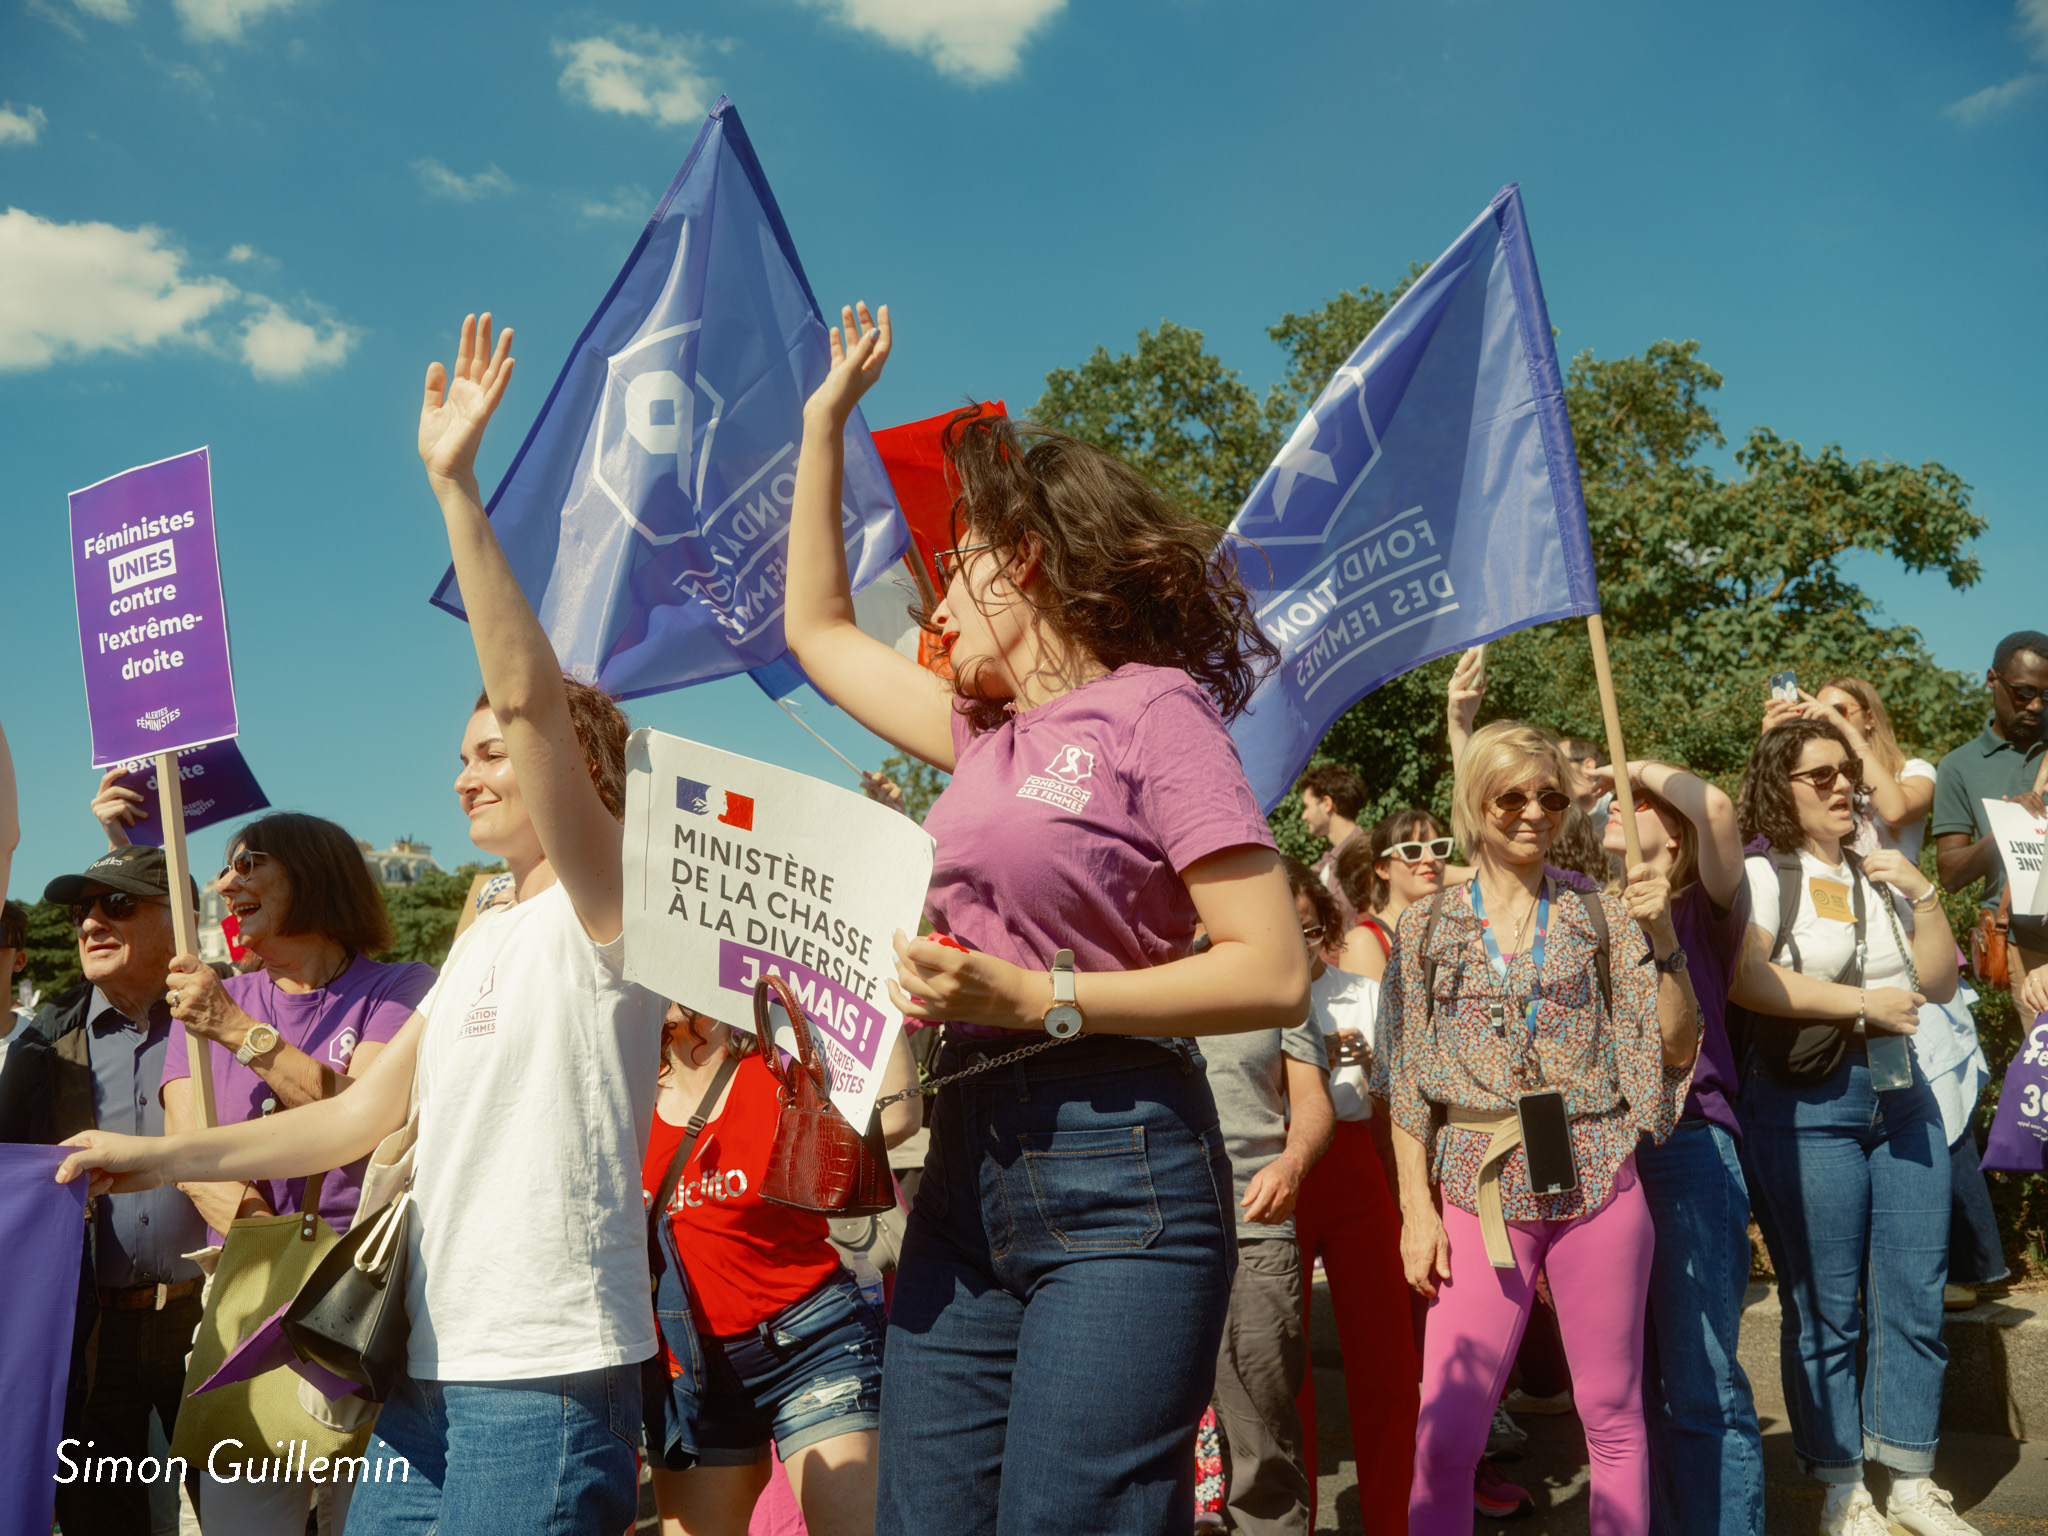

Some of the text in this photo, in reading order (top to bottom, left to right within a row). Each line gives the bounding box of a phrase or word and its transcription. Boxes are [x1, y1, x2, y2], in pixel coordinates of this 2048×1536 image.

[84, 510, 195, 559] Féministes
[112, 548, 173, 584] UNIES
[109, 584, 177, 616] contre
[98, 612, 203, 653] l'extrême-
[121, 648, 184, 680] droite
[136, 708, 180, 731] FÉMINISTES
[145, 706, 168, 719] ALERTES
[146, 763, 205, 791] dite
[1025, 776, 1090, 803] FONDATION
[1018, 787, 1084, 813] DES FEMMES
[673, 823, 835, 904] MINISTÈRE
[671, 857, 873, 966] DE LA CHASSE
[668, 886, 879, 1003] À LA DIVERSITÉ
[826, 1039, 855, 1072] ALERTES
